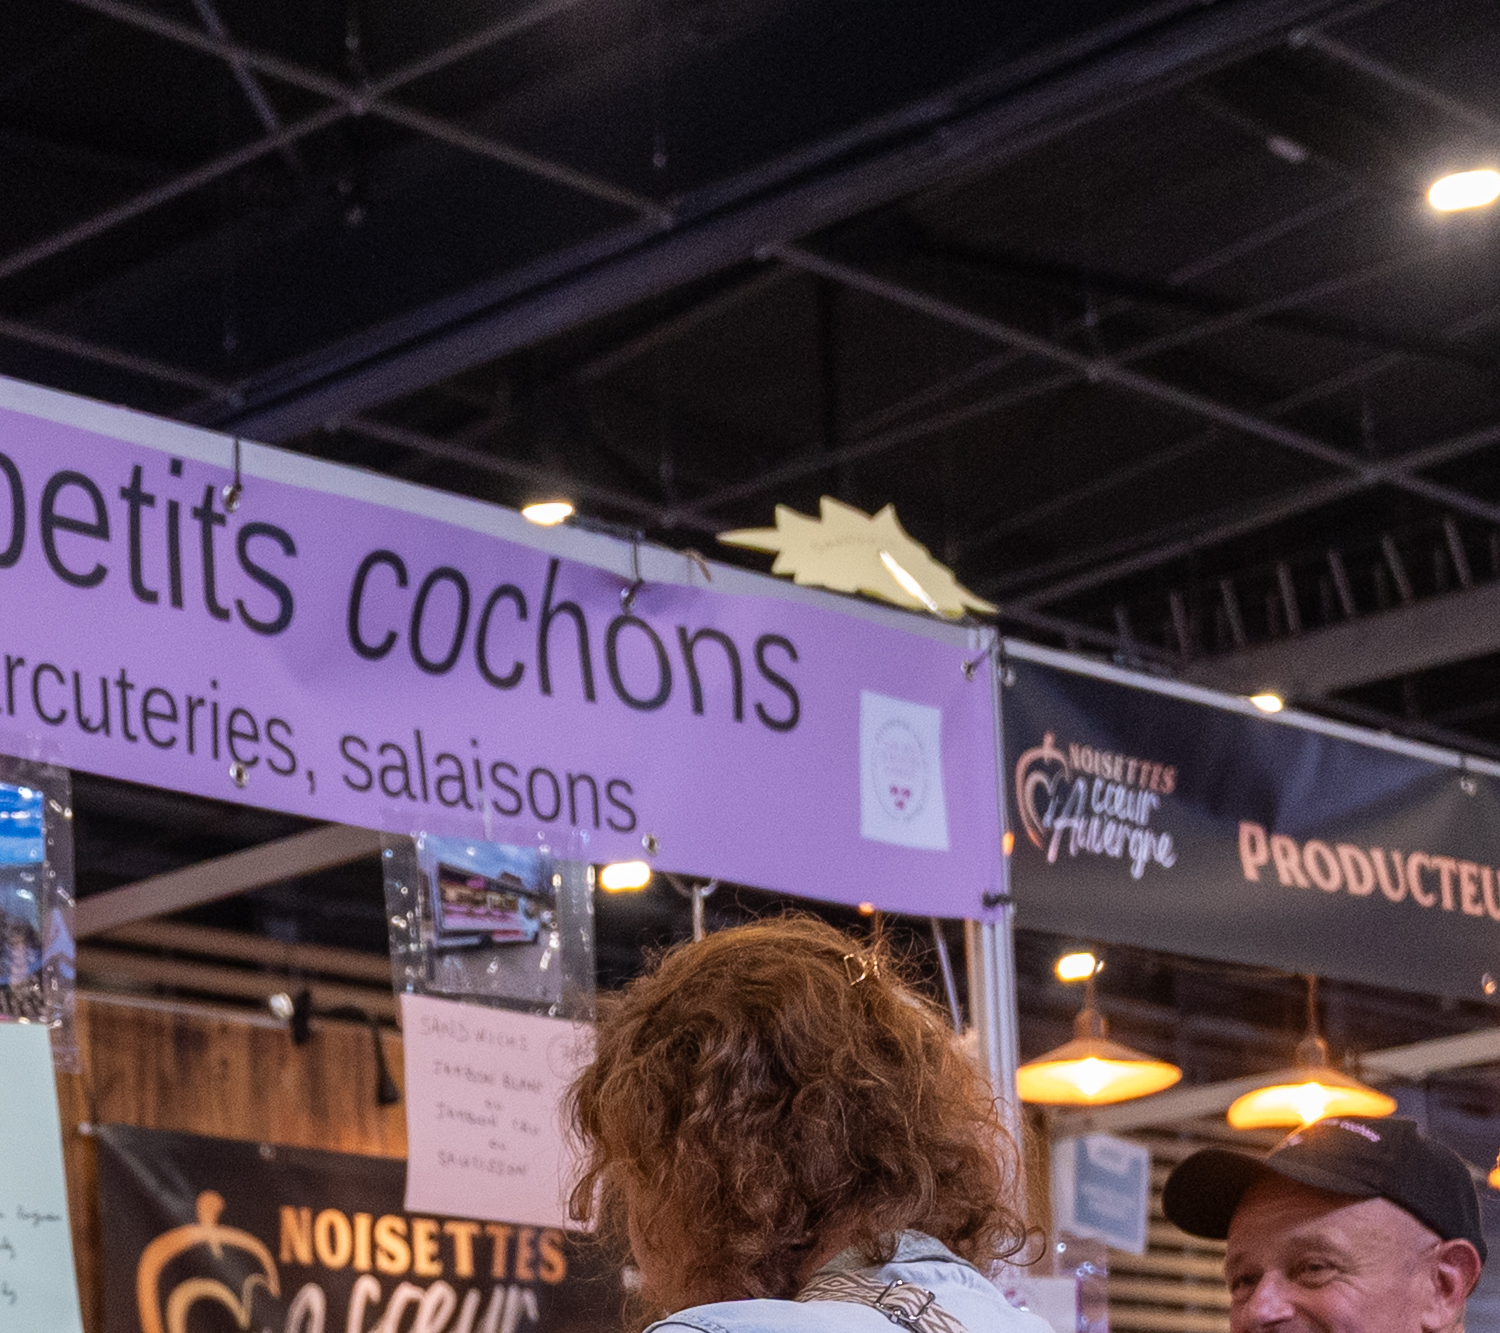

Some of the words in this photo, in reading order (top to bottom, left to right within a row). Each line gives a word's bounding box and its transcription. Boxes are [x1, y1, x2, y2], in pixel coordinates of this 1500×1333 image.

[344, 558, 801, 733] cochons
[341, 721, 639, 836] salaisons
[1069, 742, 1177, 794] NOISETTES
[279, 1206, 567, 1283] NOISETTES
